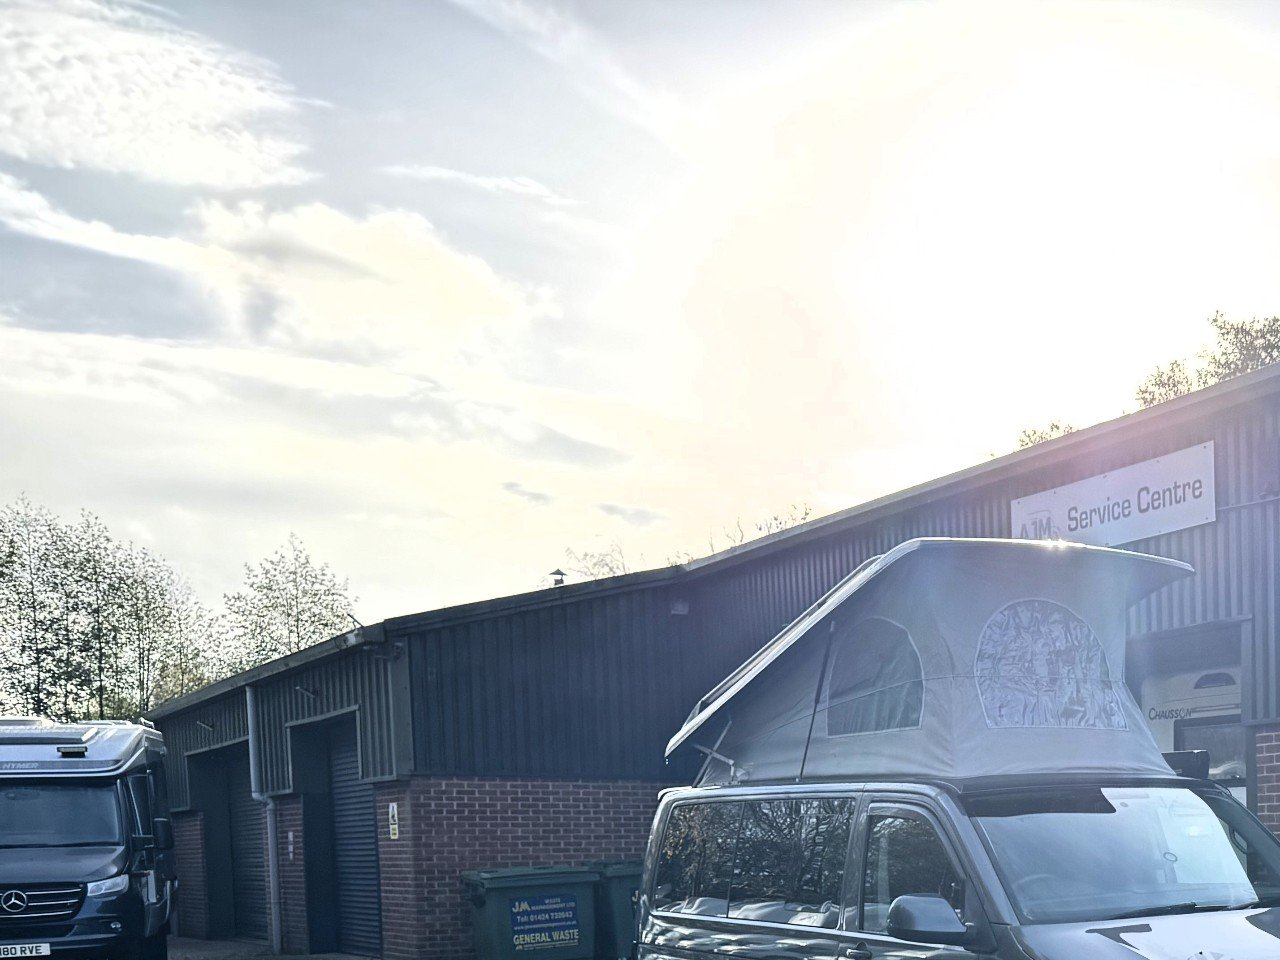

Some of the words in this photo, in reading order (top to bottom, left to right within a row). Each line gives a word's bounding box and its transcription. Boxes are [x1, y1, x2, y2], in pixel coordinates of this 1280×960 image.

[1067, 496, 1131, 531] Service
[1137, 478, 1203, 514] Centre
[1149, 707, 1192, 720] CHAUSSON
[513, 932, 551, 944] GENERAL
[552, 929, 579, 940] WASTE
[20, 945, 43, 955] RVE
